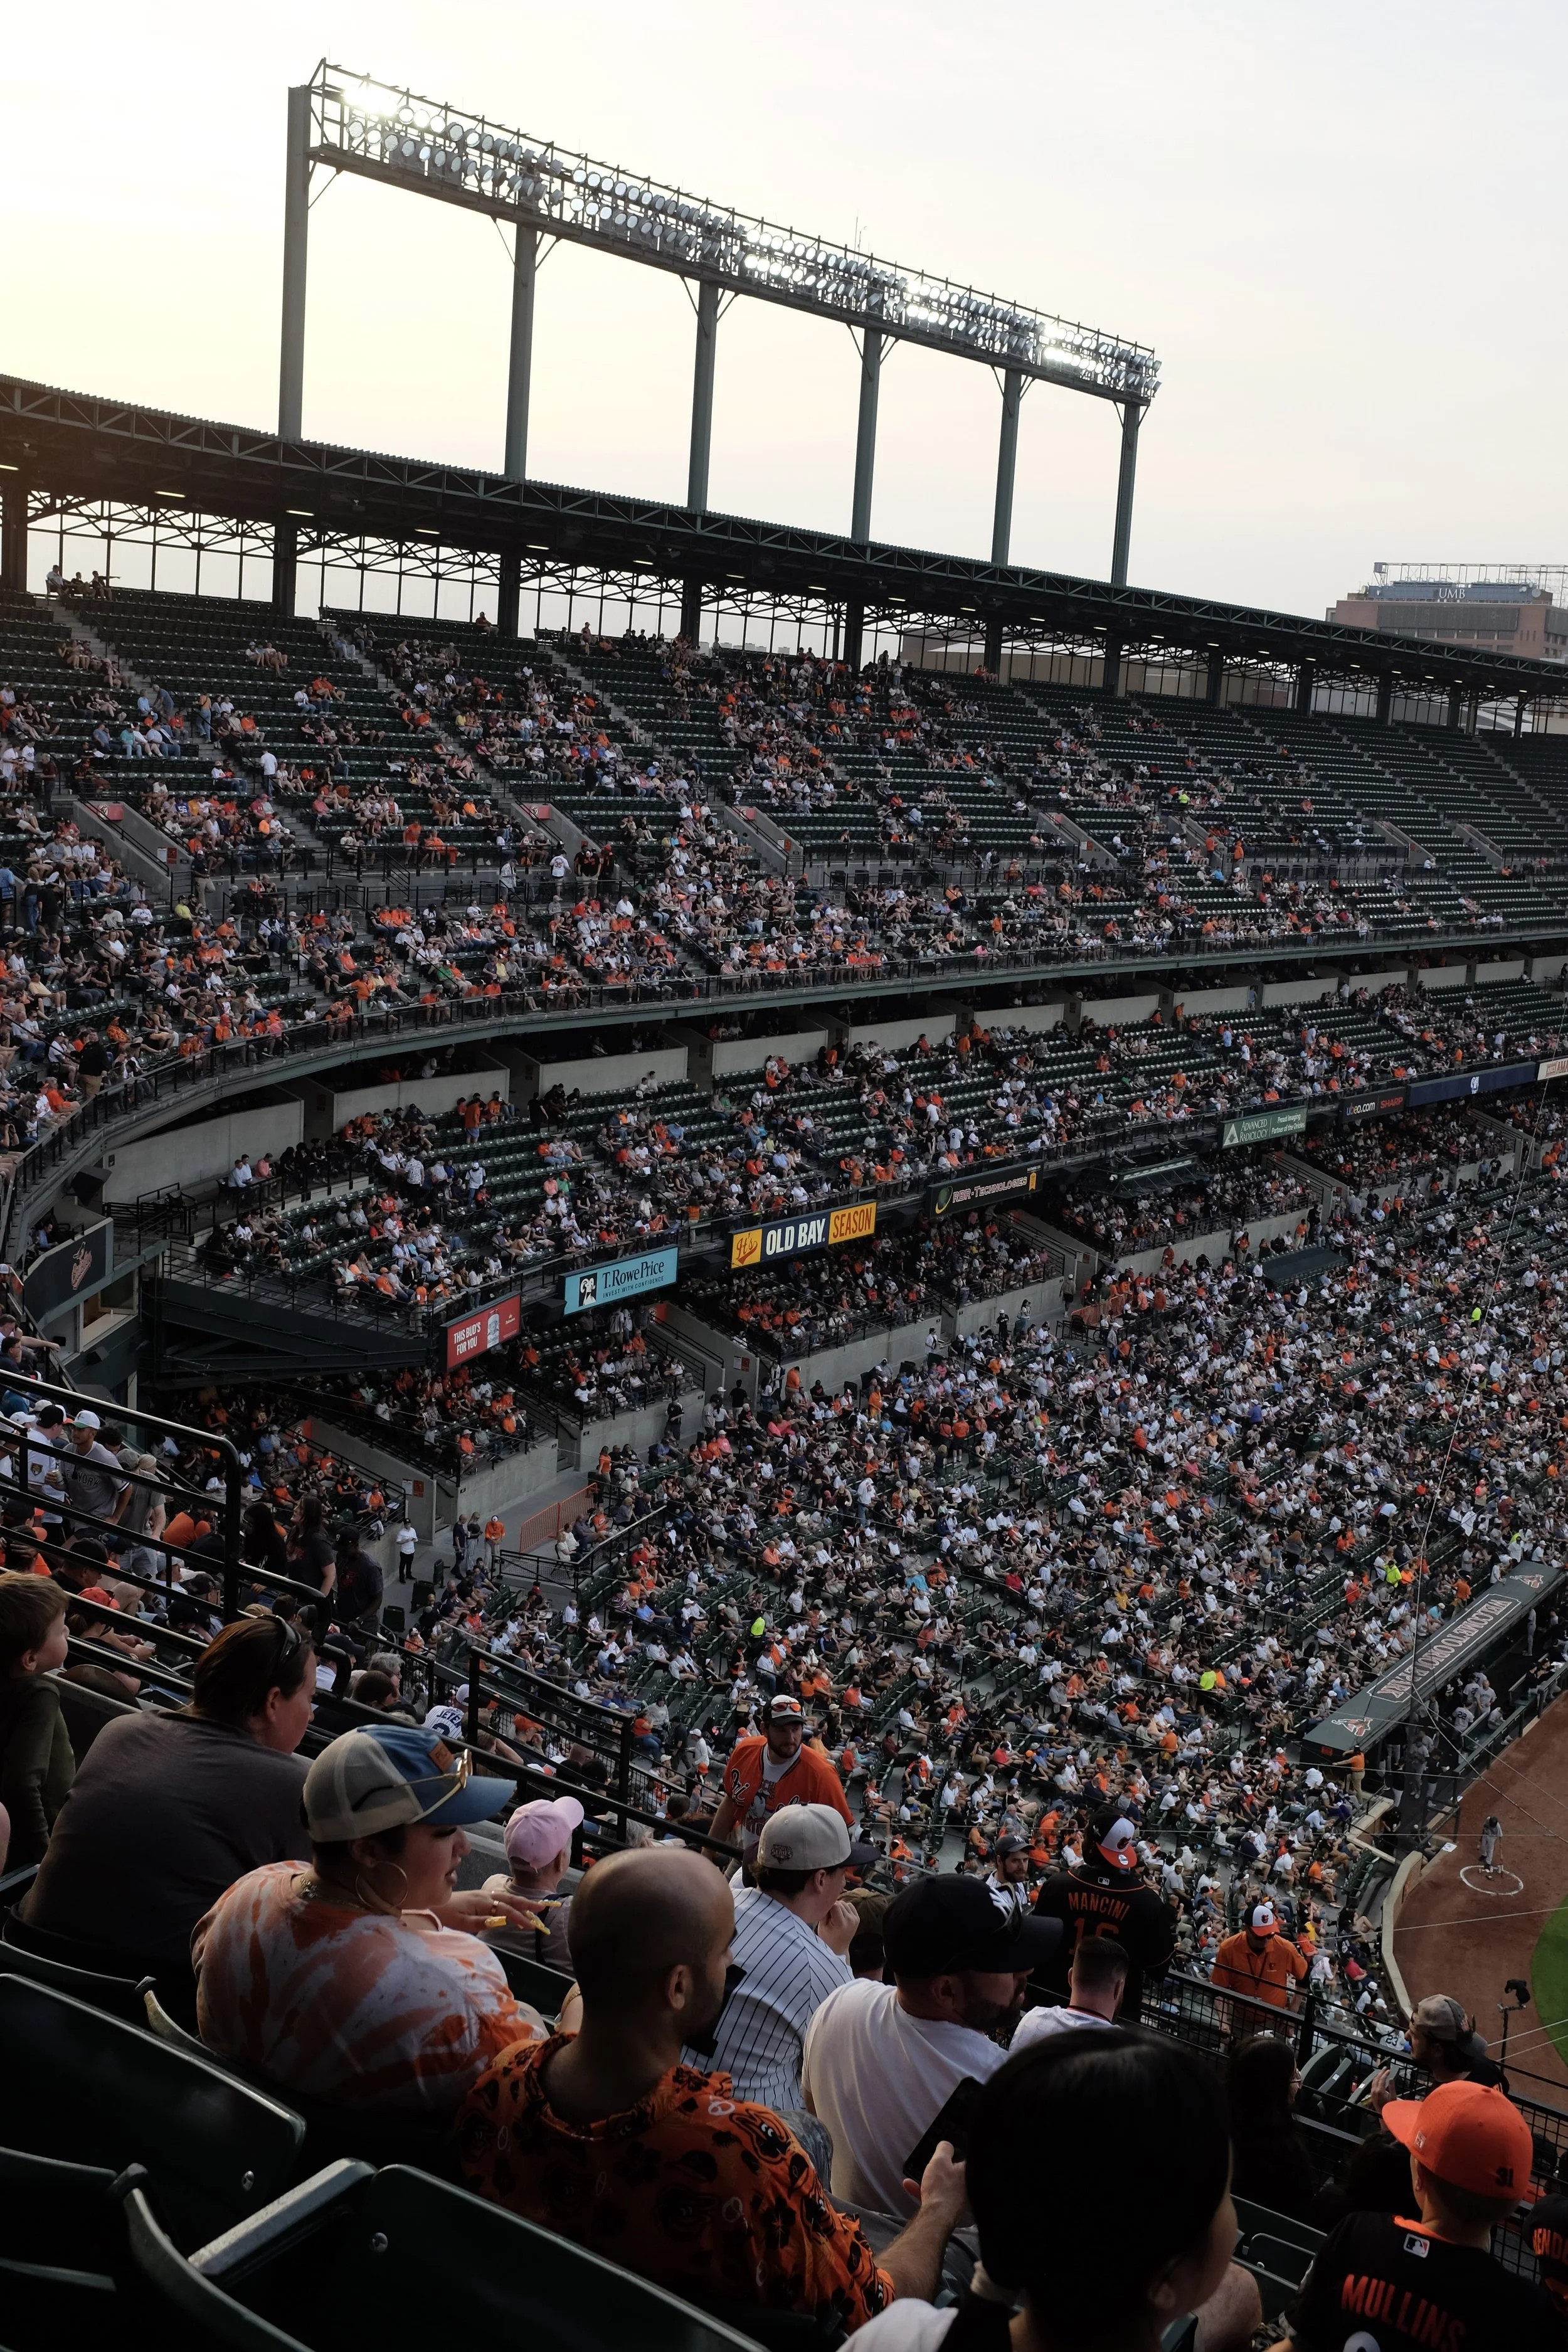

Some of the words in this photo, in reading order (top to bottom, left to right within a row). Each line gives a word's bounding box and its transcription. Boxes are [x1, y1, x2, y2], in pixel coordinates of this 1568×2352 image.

[1439, 588, 1465, 599] UMB
[1346, 1102, 1375, 1116] ubeo.com
[1380, 1096, 1403, 1108] SHARP
[1240, 1118, 1268, 1132] ADVANCED
[1277, 1115, 1288, 1124] Proud
[1288, 1113, 1301, 1123] Imaging
[1239, 1128, 1268, 1143] RADIOLOGY
[1271, 1126, 1283, 1135] Partner
[766, 1226, 795, 1255] OLD
[832, 1207, 872, 1239] SEASON
[603, 1288, 620, 1298] INVEST
[622, 1285, 634, 1293] WITH
[634, 1276, 664, 1289] CONFIDENCE
[453, 1329, 465, 1344] THIS
[465, 1322, 481, 1340] BUD'S
[457, 1342, 467, 1355] FOR
[467, 1336, 477, 1350] YOU
[1451, 1599, 1512, 1638] WELCOME
[1439, 1631, 1471, 1648] TO
[1402, 1645, 1456, 1682] ORIOLE
[1377, 1669, 1422, 1698] PARK
[1068, 1892, 1130, 1921] MANCINI
[1386, 2034, 1398, 2046] 23
[1341, 2274, 1466, 2352] MULLINS
